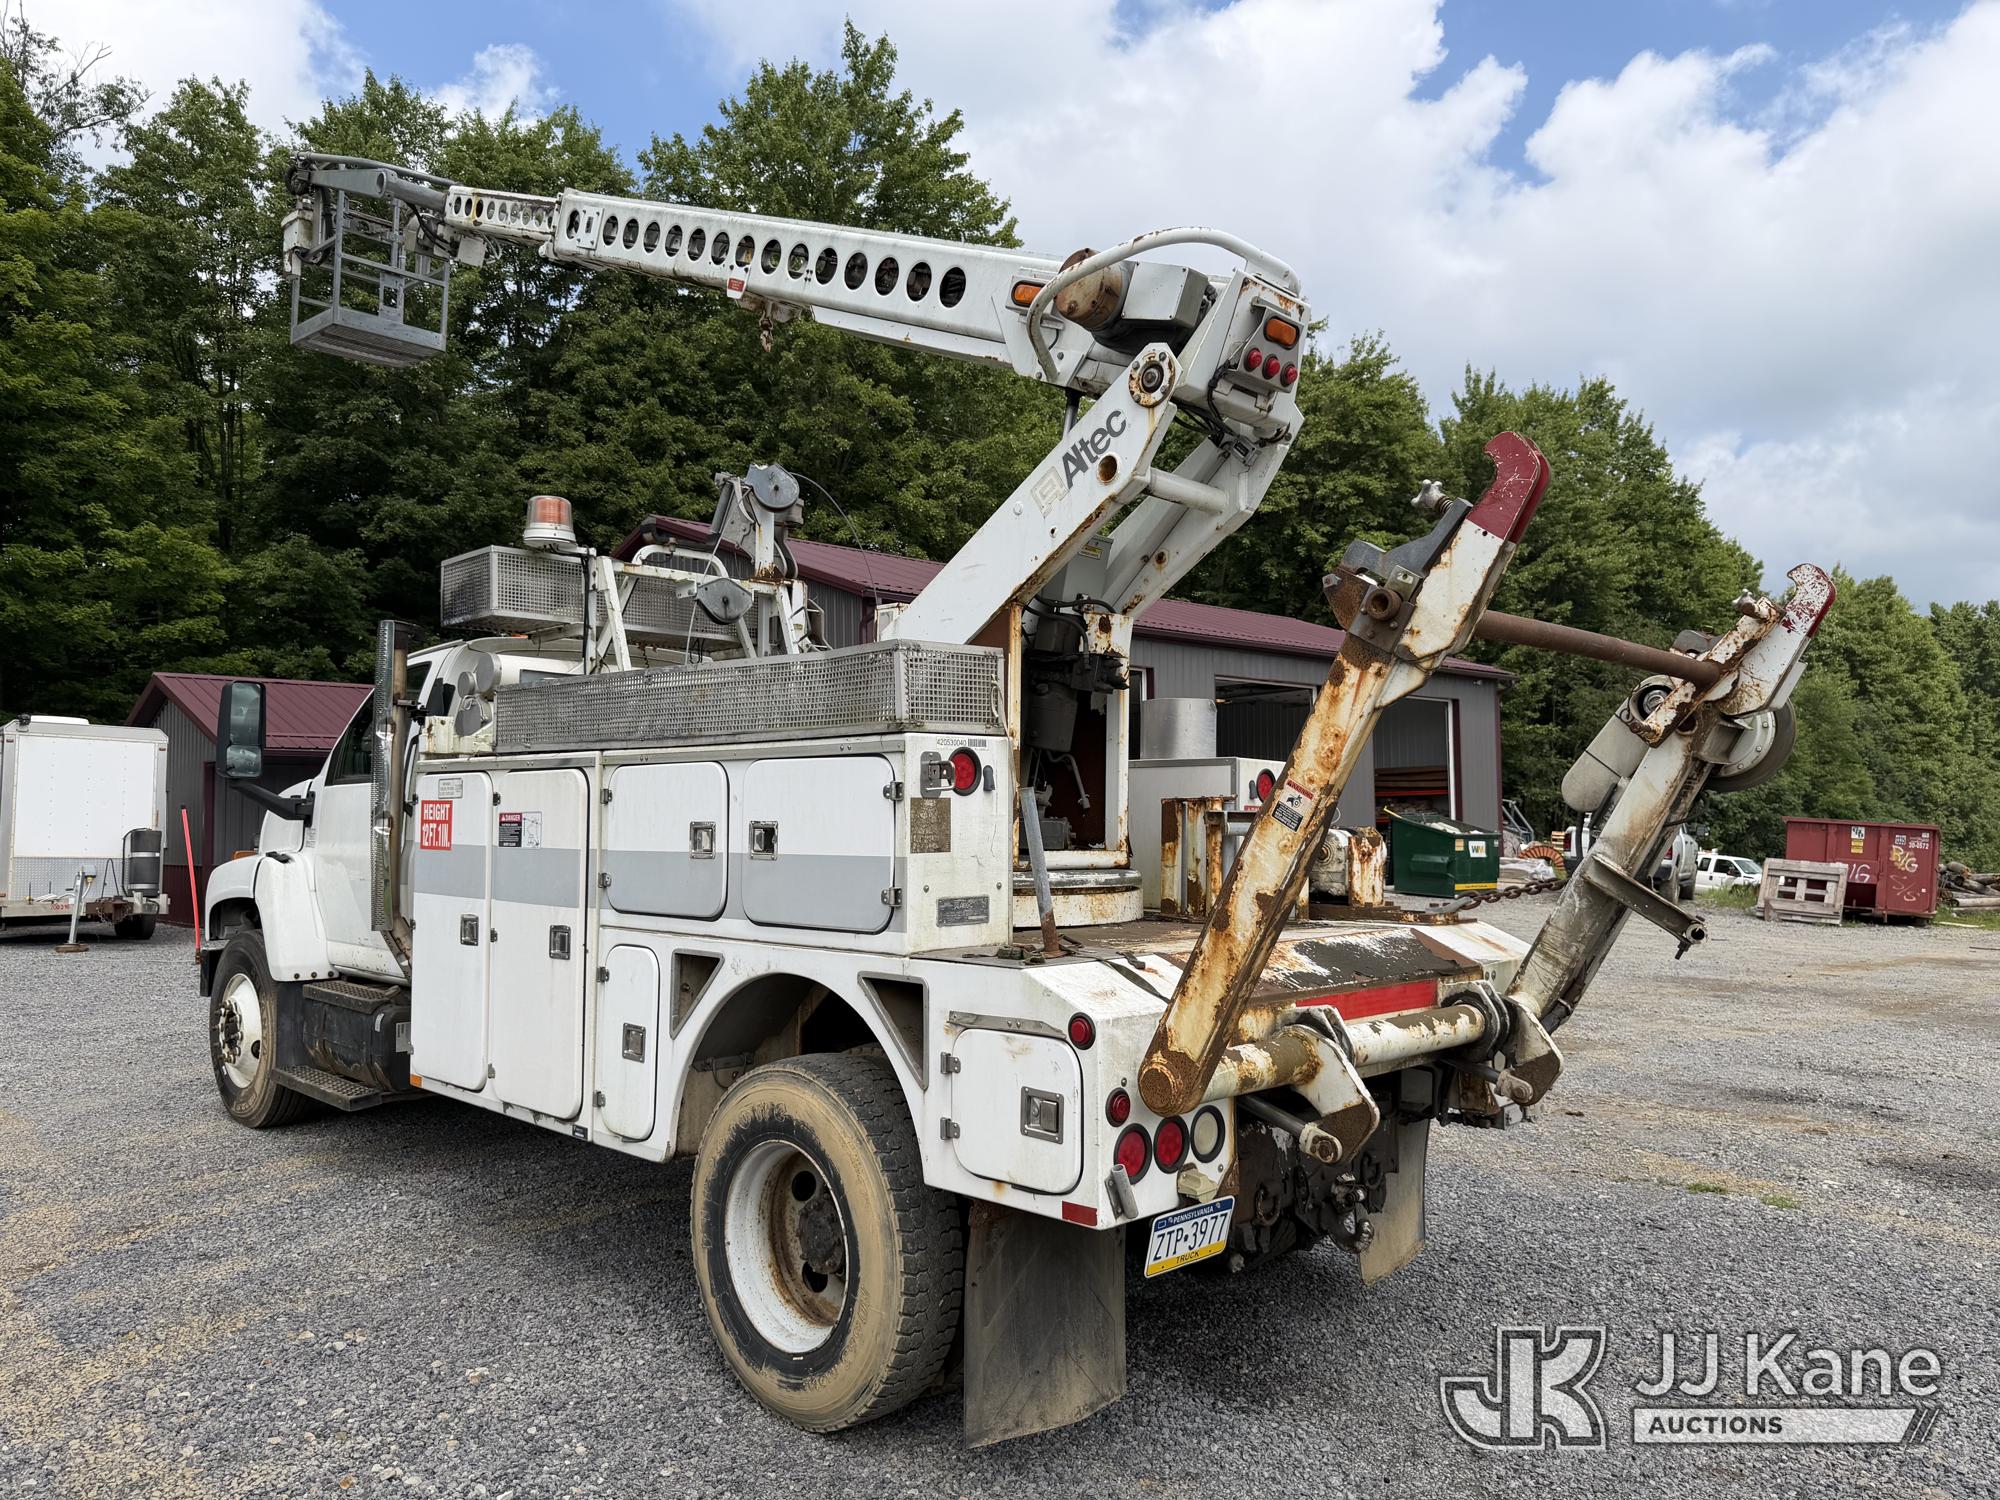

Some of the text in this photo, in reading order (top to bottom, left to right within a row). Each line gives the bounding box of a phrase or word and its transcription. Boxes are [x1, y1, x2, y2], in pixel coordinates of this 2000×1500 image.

[1062, 410, 1126, 490] Altec
[423, 803, 450, 821] HEIGHT
[1173, 1205, 1214, 1224] PENNSYLVANIA
[1176, 1250, 1200, 1264] TRUCK
